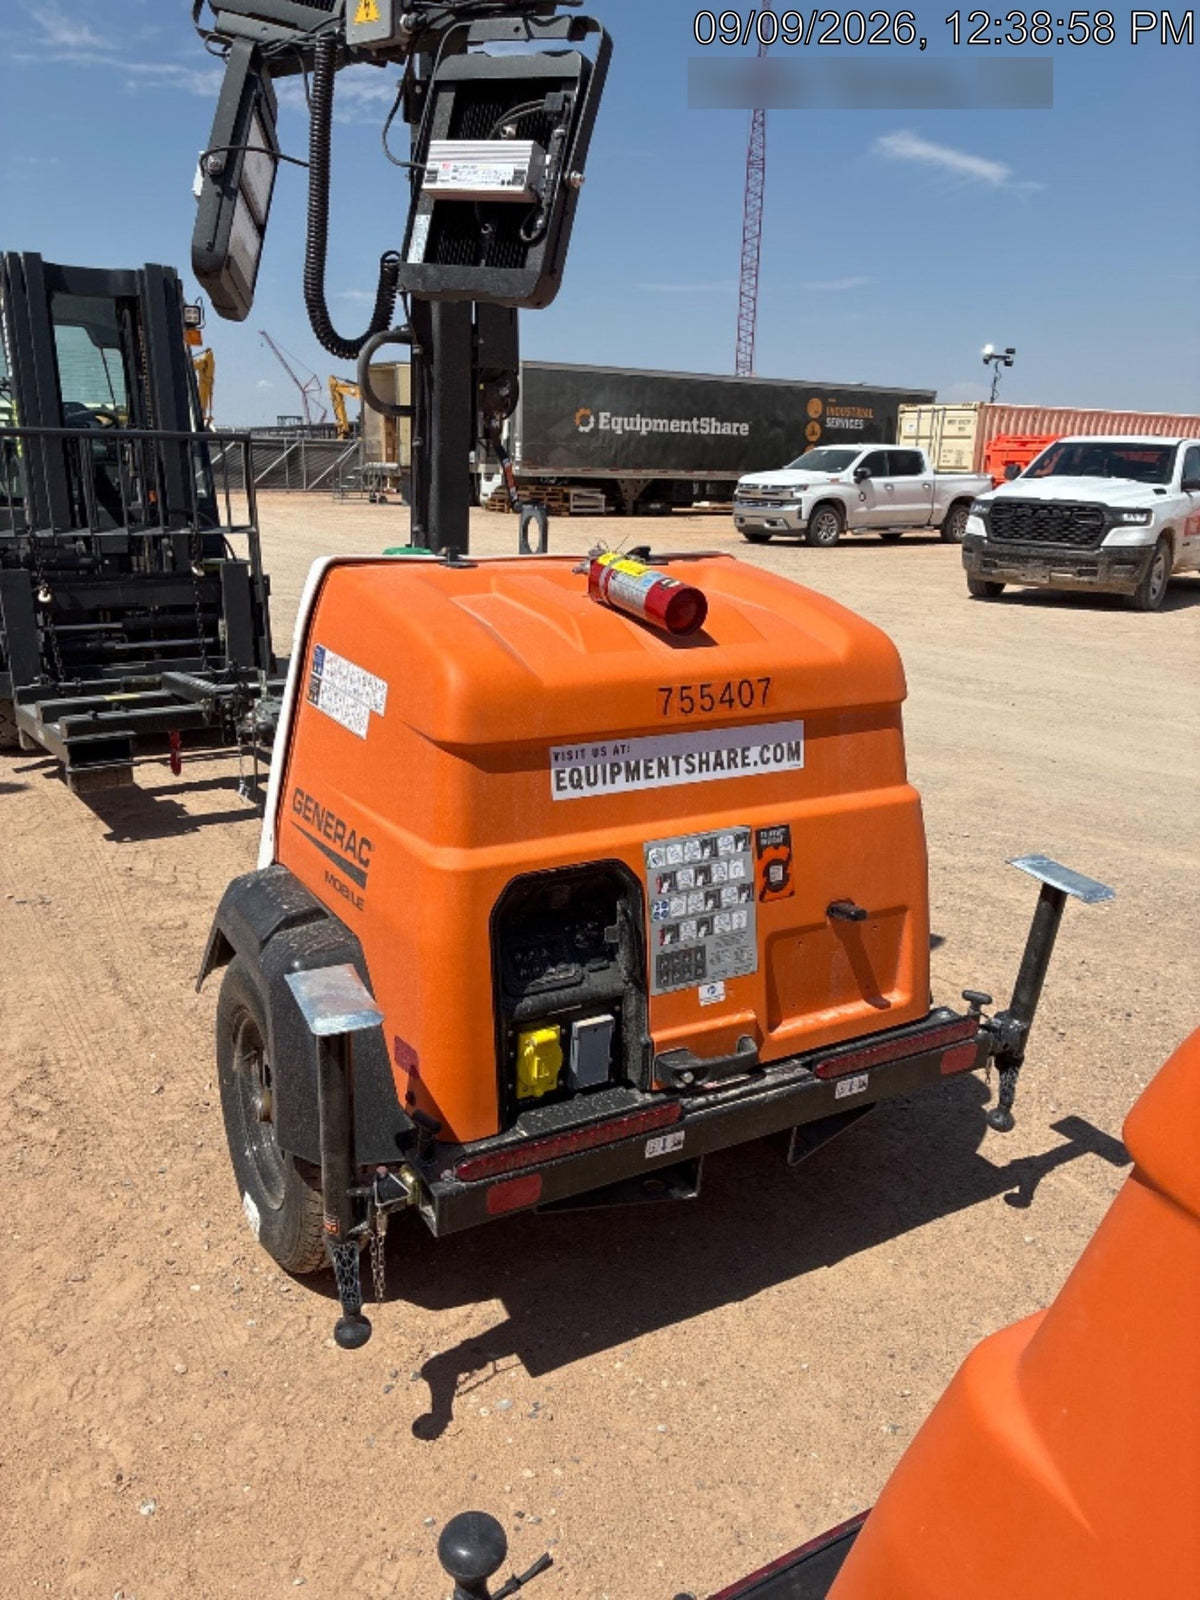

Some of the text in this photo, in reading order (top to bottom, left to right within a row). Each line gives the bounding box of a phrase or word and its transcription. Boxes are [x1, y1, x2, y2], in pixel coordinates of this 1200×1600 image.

[598, 412, 750, 436] EquipmentShare
[658, 677, 771, 715] 755407
[553, 744, 631, 762] VISIT US AT:
[555, 740, 801, 791] EQUIPMENTSHARE.COM
[293, 787, 372, 868] GENERAC
[324, 869, 365, 911] MOBILE
